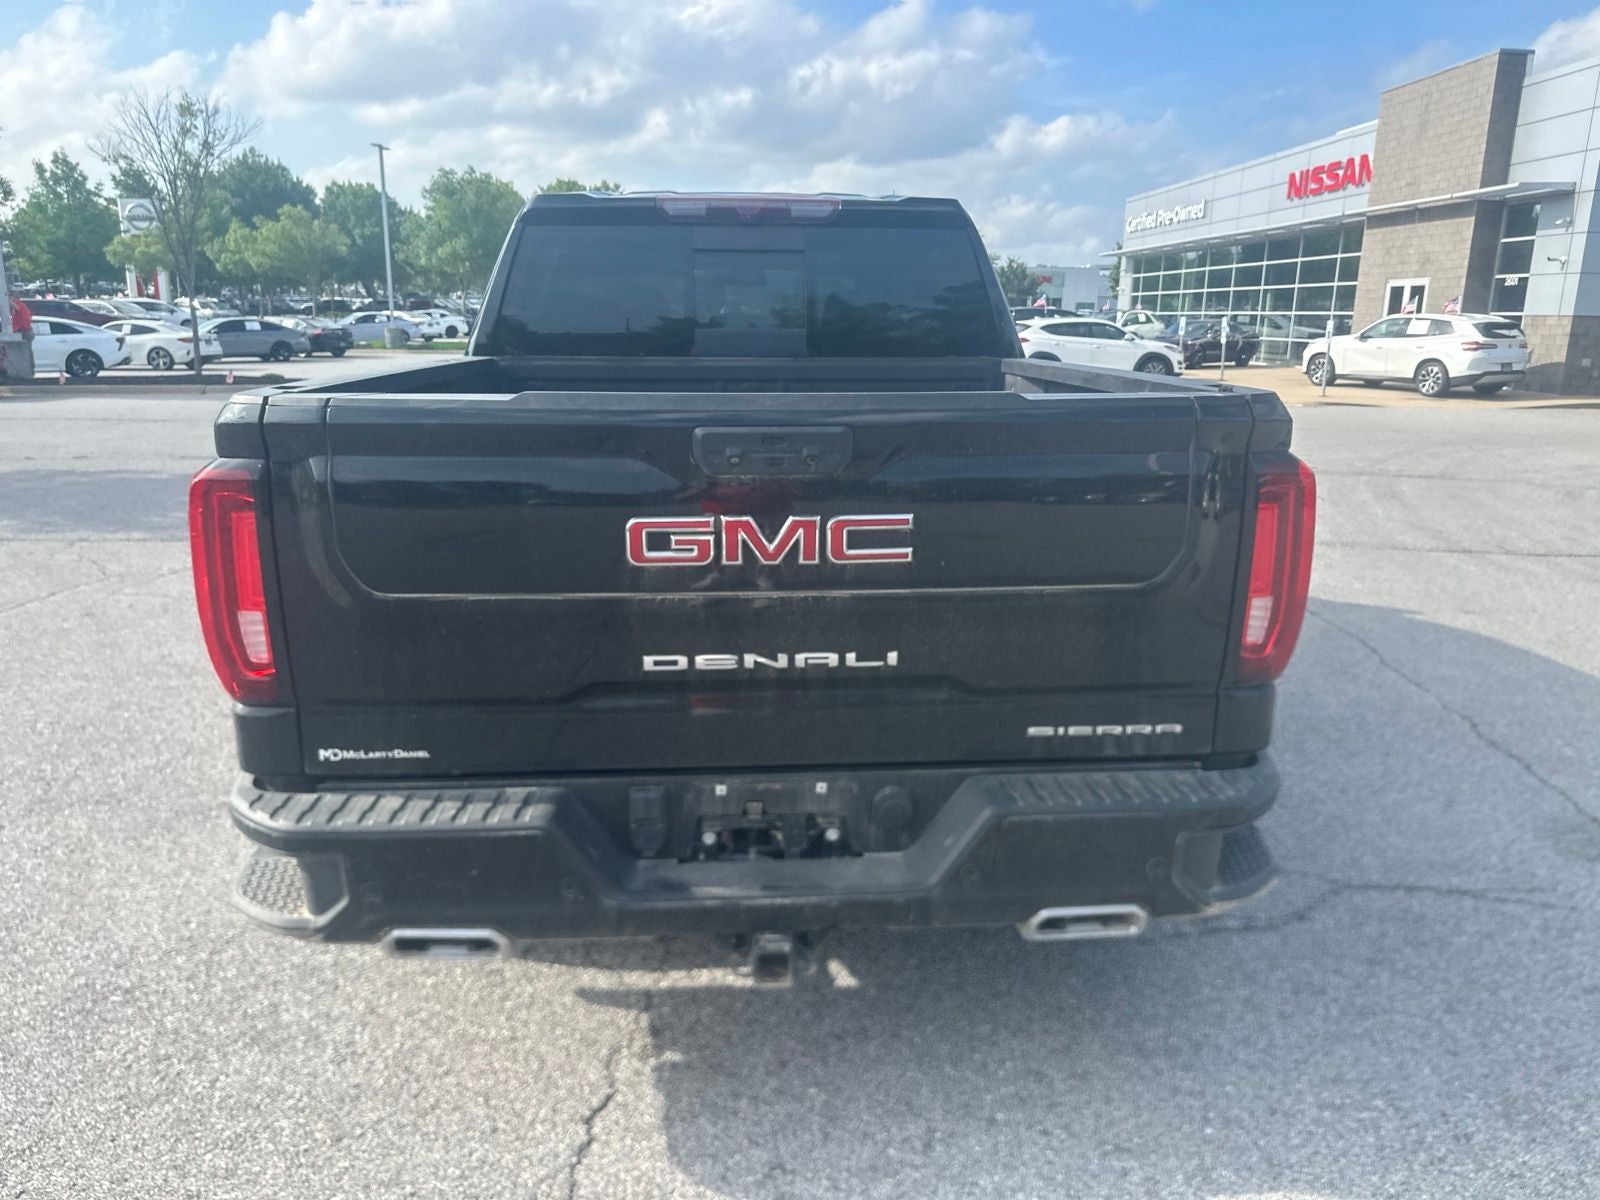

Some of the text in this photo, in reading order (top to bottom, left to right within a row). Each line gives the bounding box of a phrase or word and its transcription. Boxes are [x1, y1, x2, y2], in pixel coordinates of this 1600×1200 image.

[1126, 199, 1205, 233] Certified Pre-Owned
[626, 513, 914, 565] GMC
[643, 651, 898, 671] DENALI
[1027, 724, 1183, 736] SIERRA
